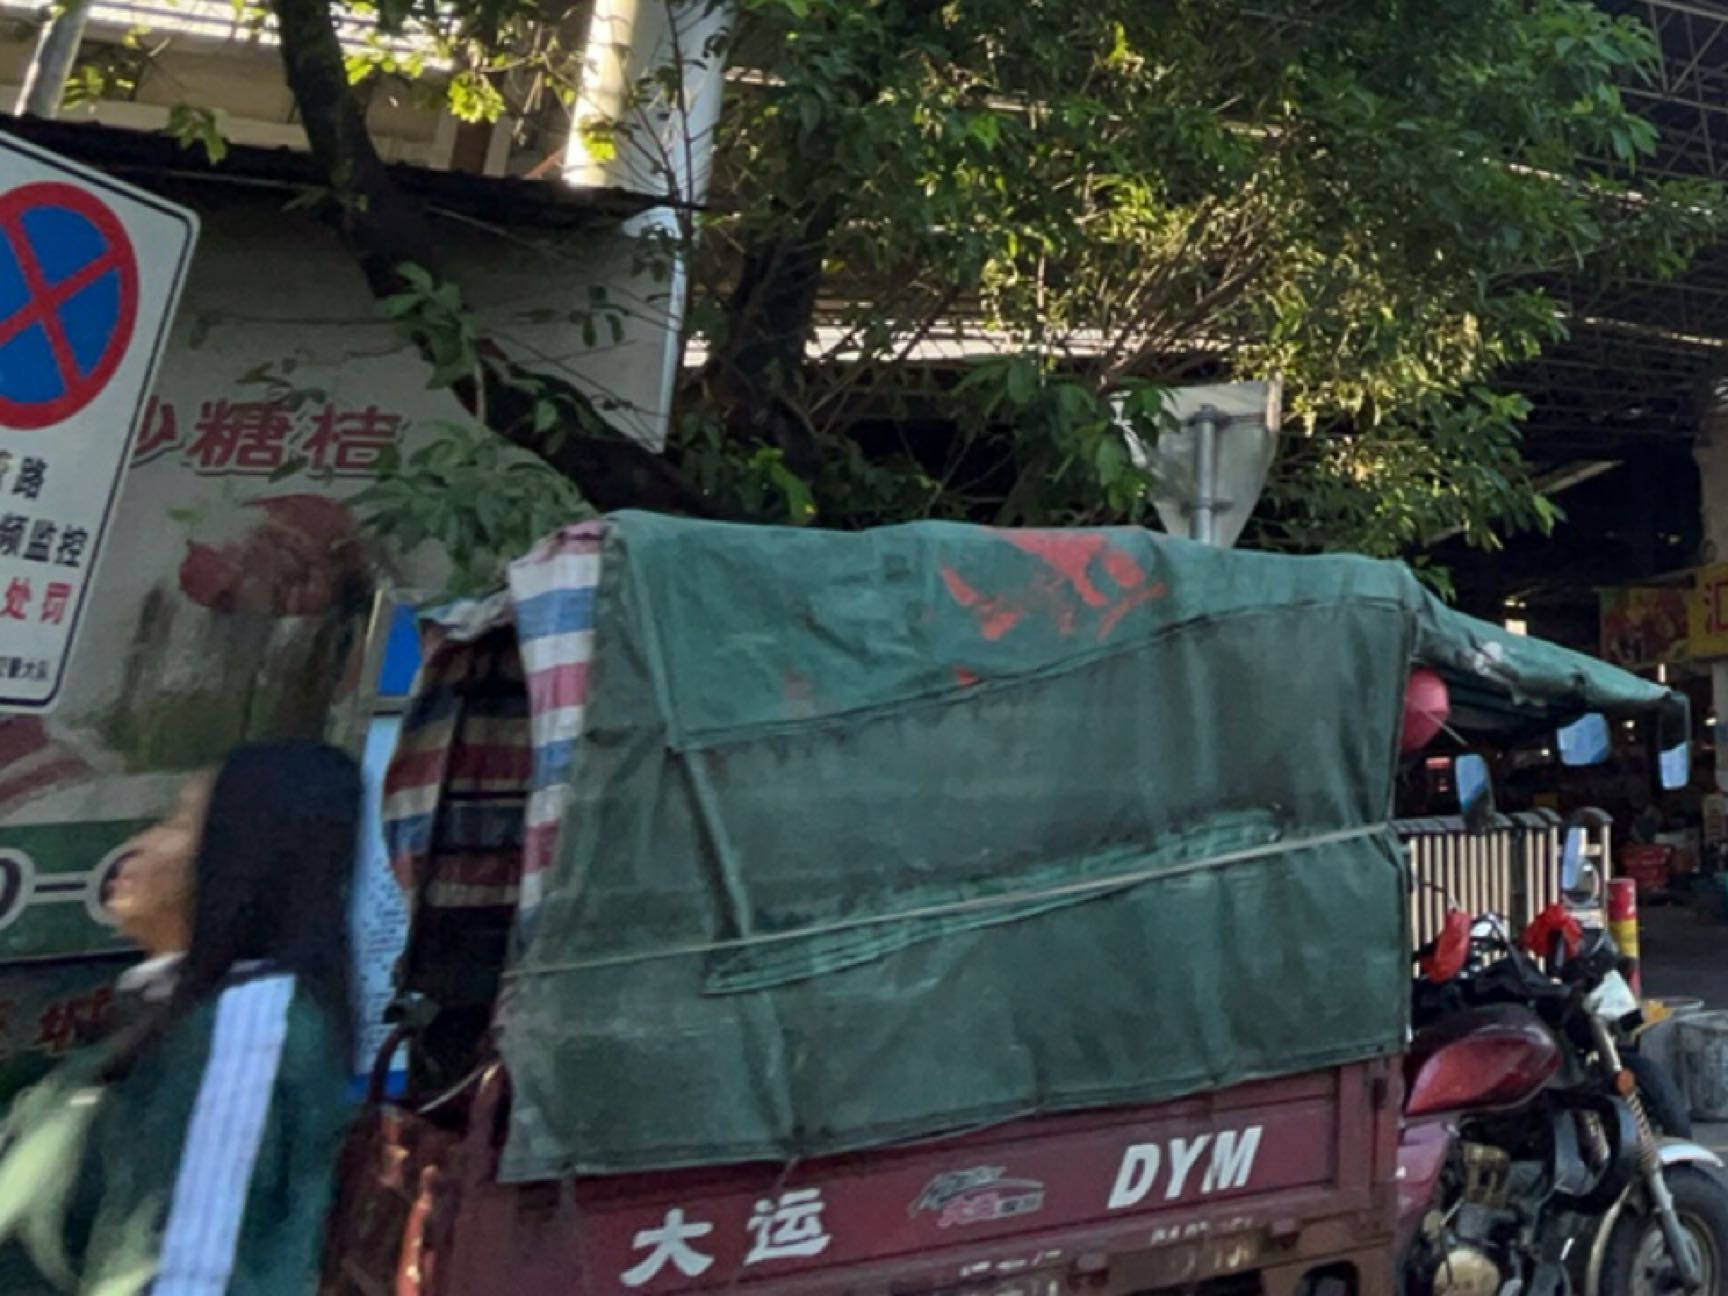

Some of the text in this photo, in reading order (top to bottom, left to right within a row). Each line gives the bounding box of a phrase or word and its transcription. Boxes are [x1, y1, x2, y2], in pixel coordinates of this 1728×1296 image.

[2, 576, 74, 625] 处罚
[1107, 1124, 1264, 1210] DYM
[619, 1187, 833, 1288] 大运
